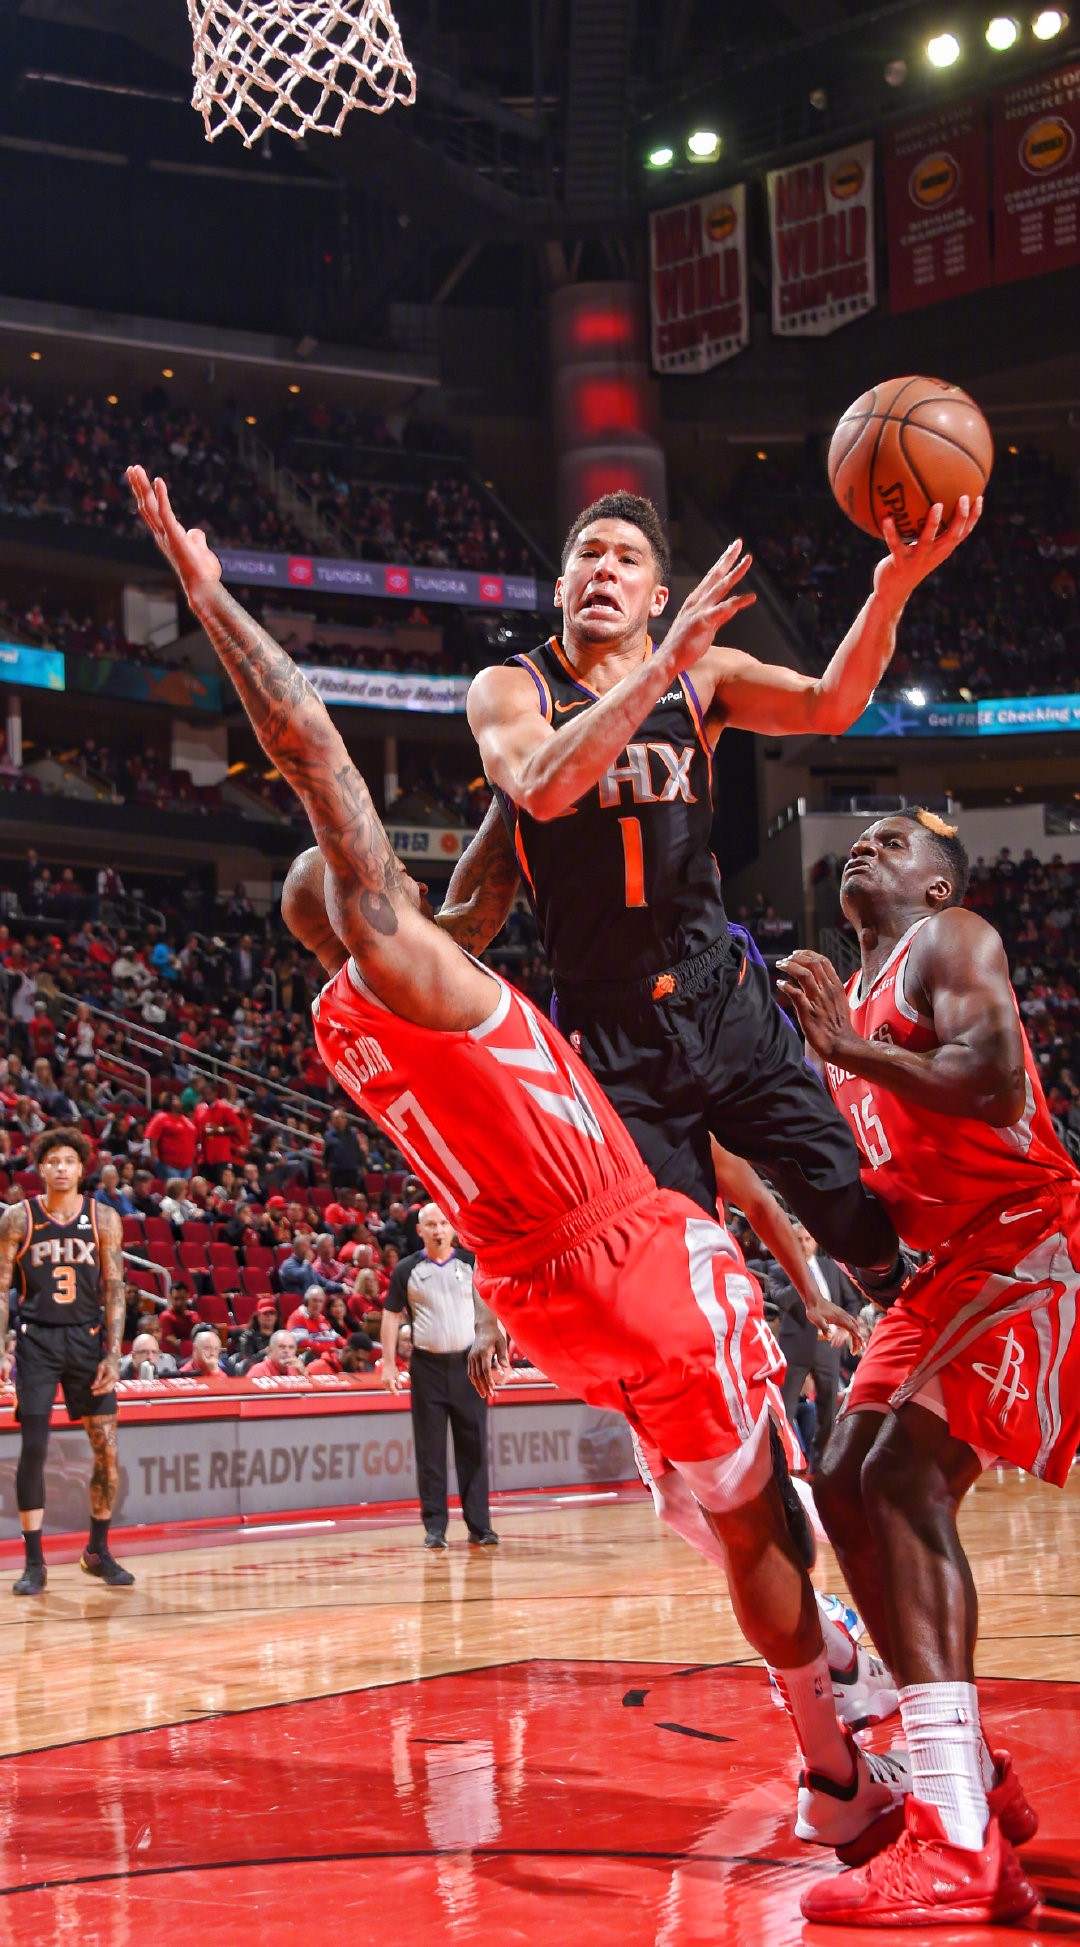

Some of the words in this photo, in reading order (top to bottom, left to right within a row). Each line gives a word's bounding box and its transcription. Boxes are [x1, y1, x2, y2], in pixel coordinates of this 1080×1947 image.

[775, 162, 827, 228] NBA
[317, 566, 373, 586] TUNDRA
[413, 575, 467, 595] TUNDRA
[656, 690, 682, 704] yPal
[928, 712, 954, 727] Get
[956, 711, 994, 726] FREE
[997, 706, 1070, 724] Checking
[599, 743, 699, 808] HX
[618, 816, 648, 908] 1
[850, 1091, 892, 1171] 15
[30, 1237, 96, 1268] PHX
[52, 1265, 77, 1304] 3
[138, 1453, 201, 1495] THE
[501, 1429, 571, 1466] EVENT
